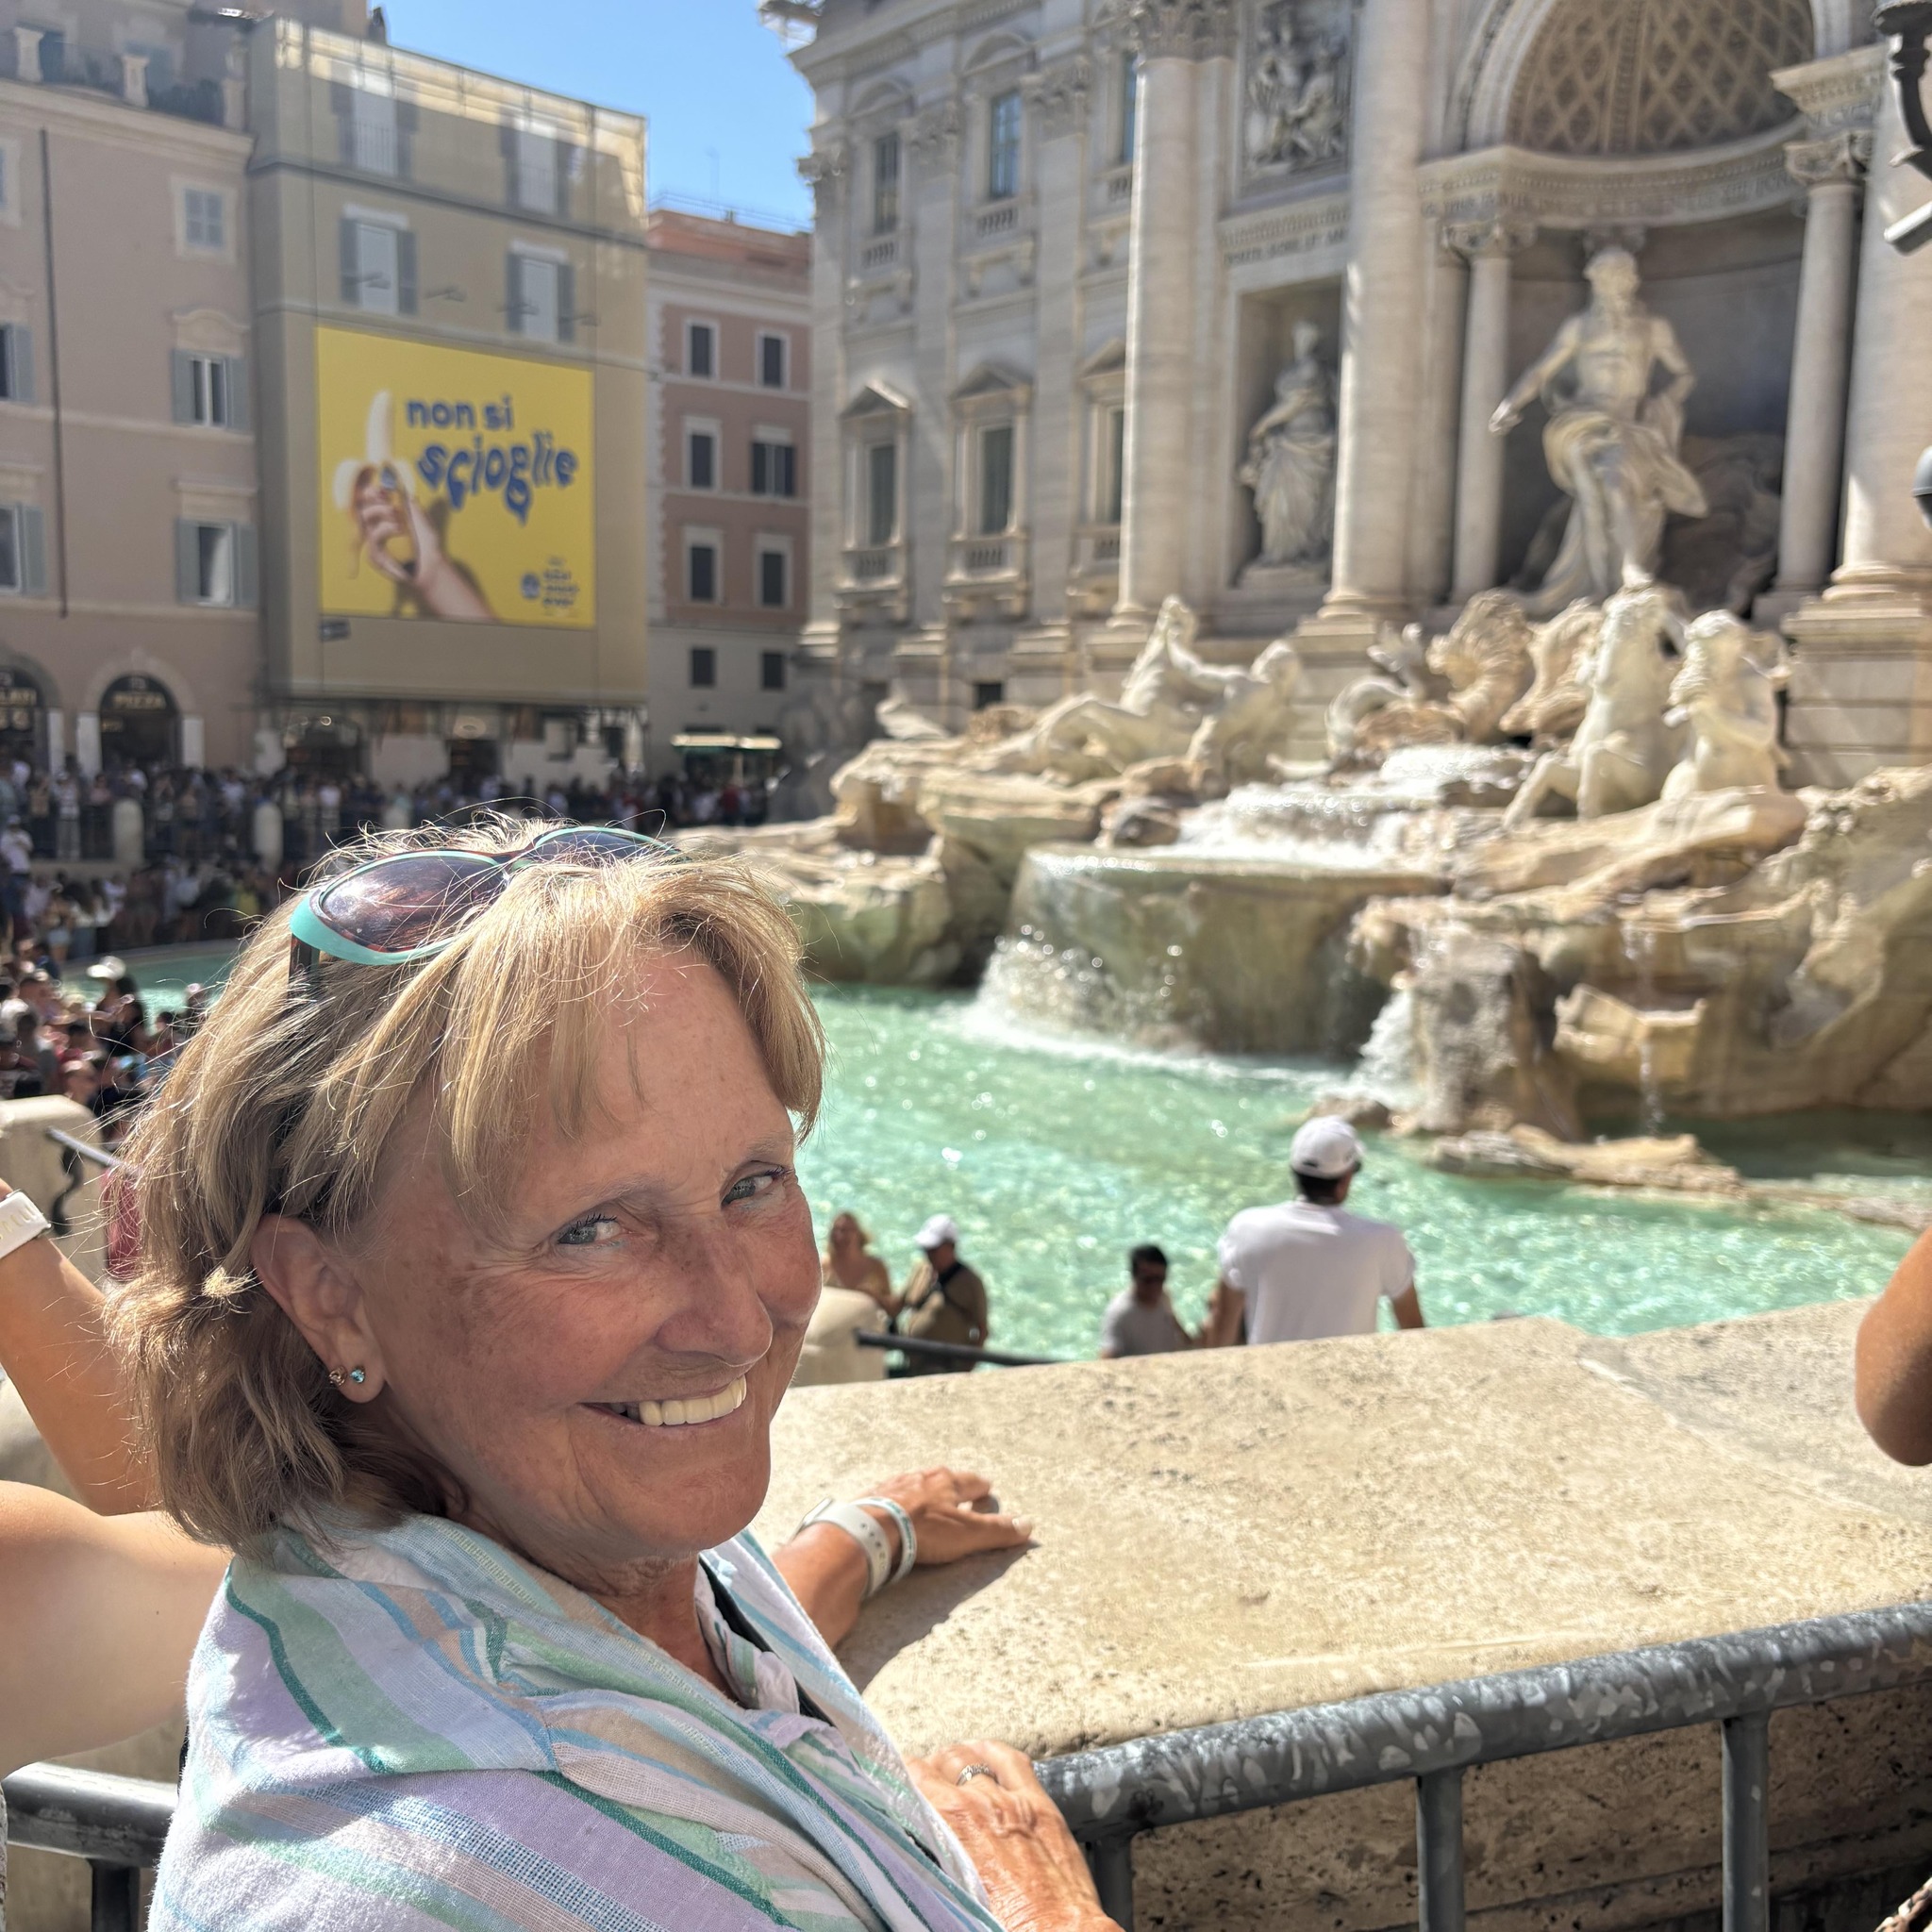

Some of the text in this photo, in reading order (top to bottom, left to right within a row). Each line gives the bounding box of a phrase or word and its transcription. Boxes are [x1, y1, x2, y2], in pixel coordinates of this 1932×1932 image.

[407, 392, 513, 430] non si
[417, 429, 577, 525] scioglie
